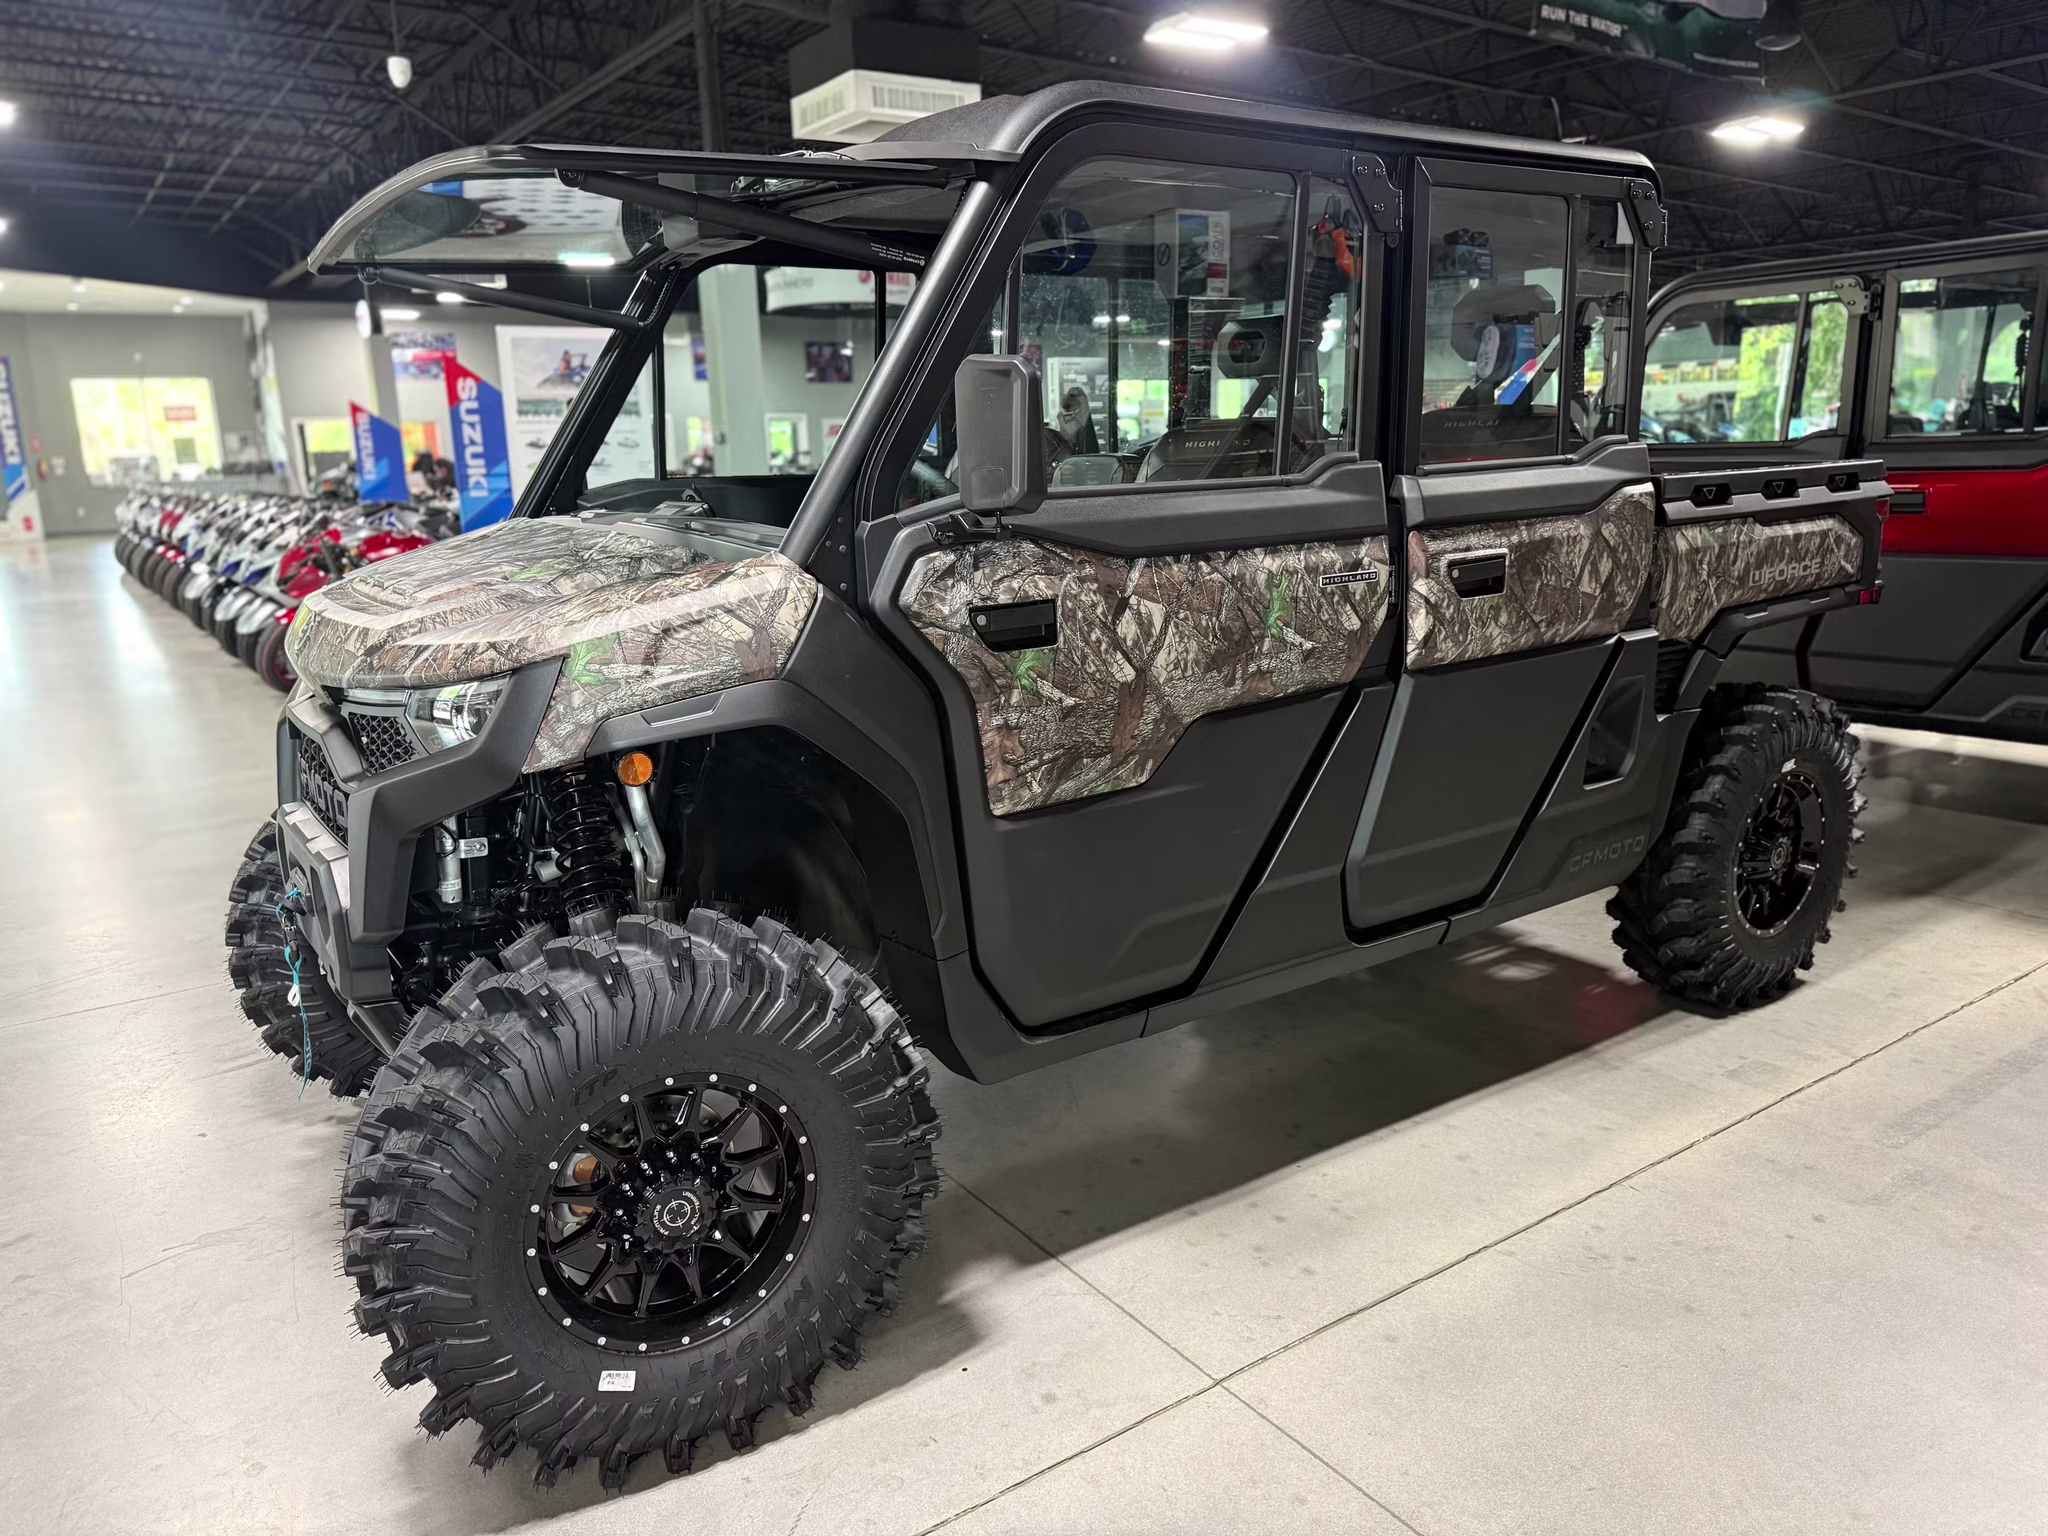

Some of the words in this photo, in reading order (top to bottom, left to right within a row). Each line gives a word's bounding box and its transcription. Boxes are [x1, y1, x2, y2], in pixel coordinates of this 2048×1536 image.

[1541, 4, 1567, 22] RUN
[1568, 9, 1589, 28] THE
[356, 410, 377, 481] SUZUKI
[457, 376, 490, 499] SUZUKI
[1323, 572, 1376, 584] HIGHLAND
[1570, 835, 1645, 872] CFMOTO
[573, 1068, 618, 1107] ITP
